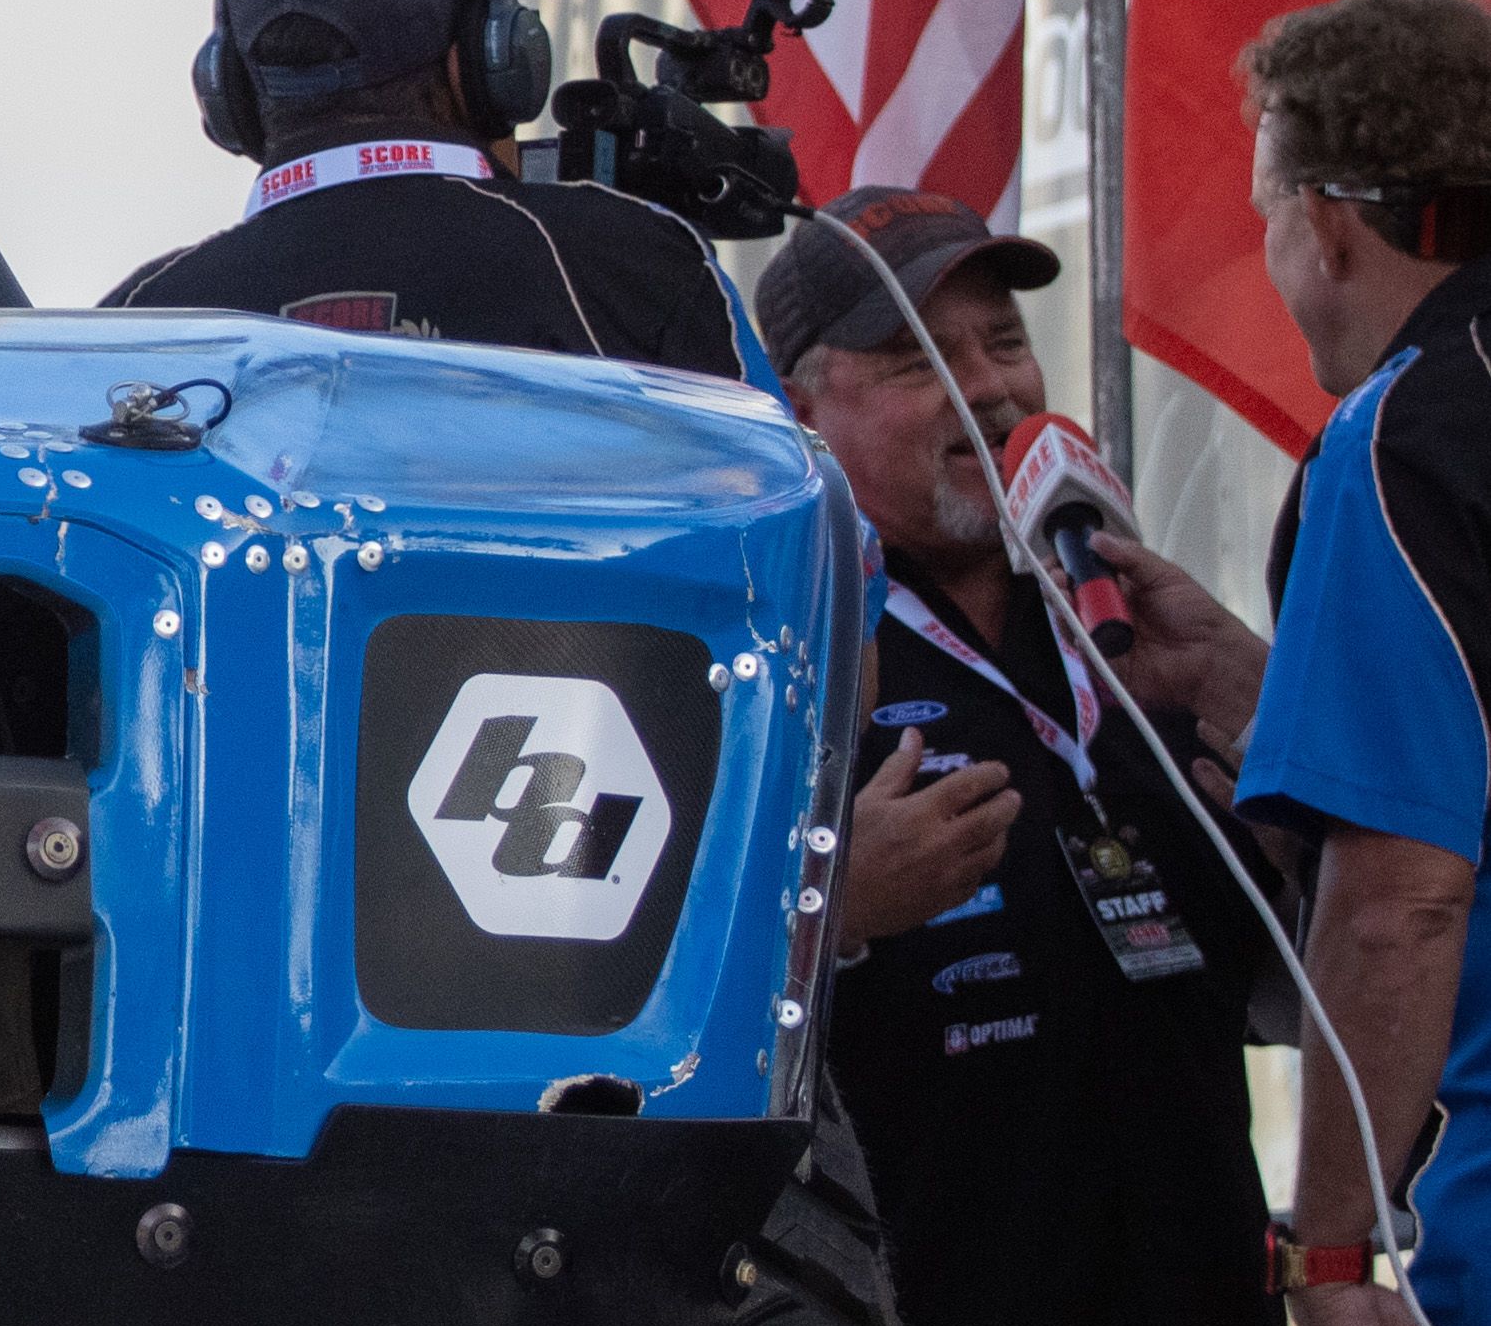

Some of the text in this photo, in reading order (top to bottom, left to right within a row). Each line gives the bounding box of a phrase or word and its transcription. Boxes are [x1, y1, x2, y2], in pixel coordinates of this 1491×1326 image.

[359, 145, 432, 165] SCORE
[262, 160, 315, 195] SCORE
[1096, 890, 1166, 921] STAFF
[970, 1015, 1035, 1046] OPTIMA
